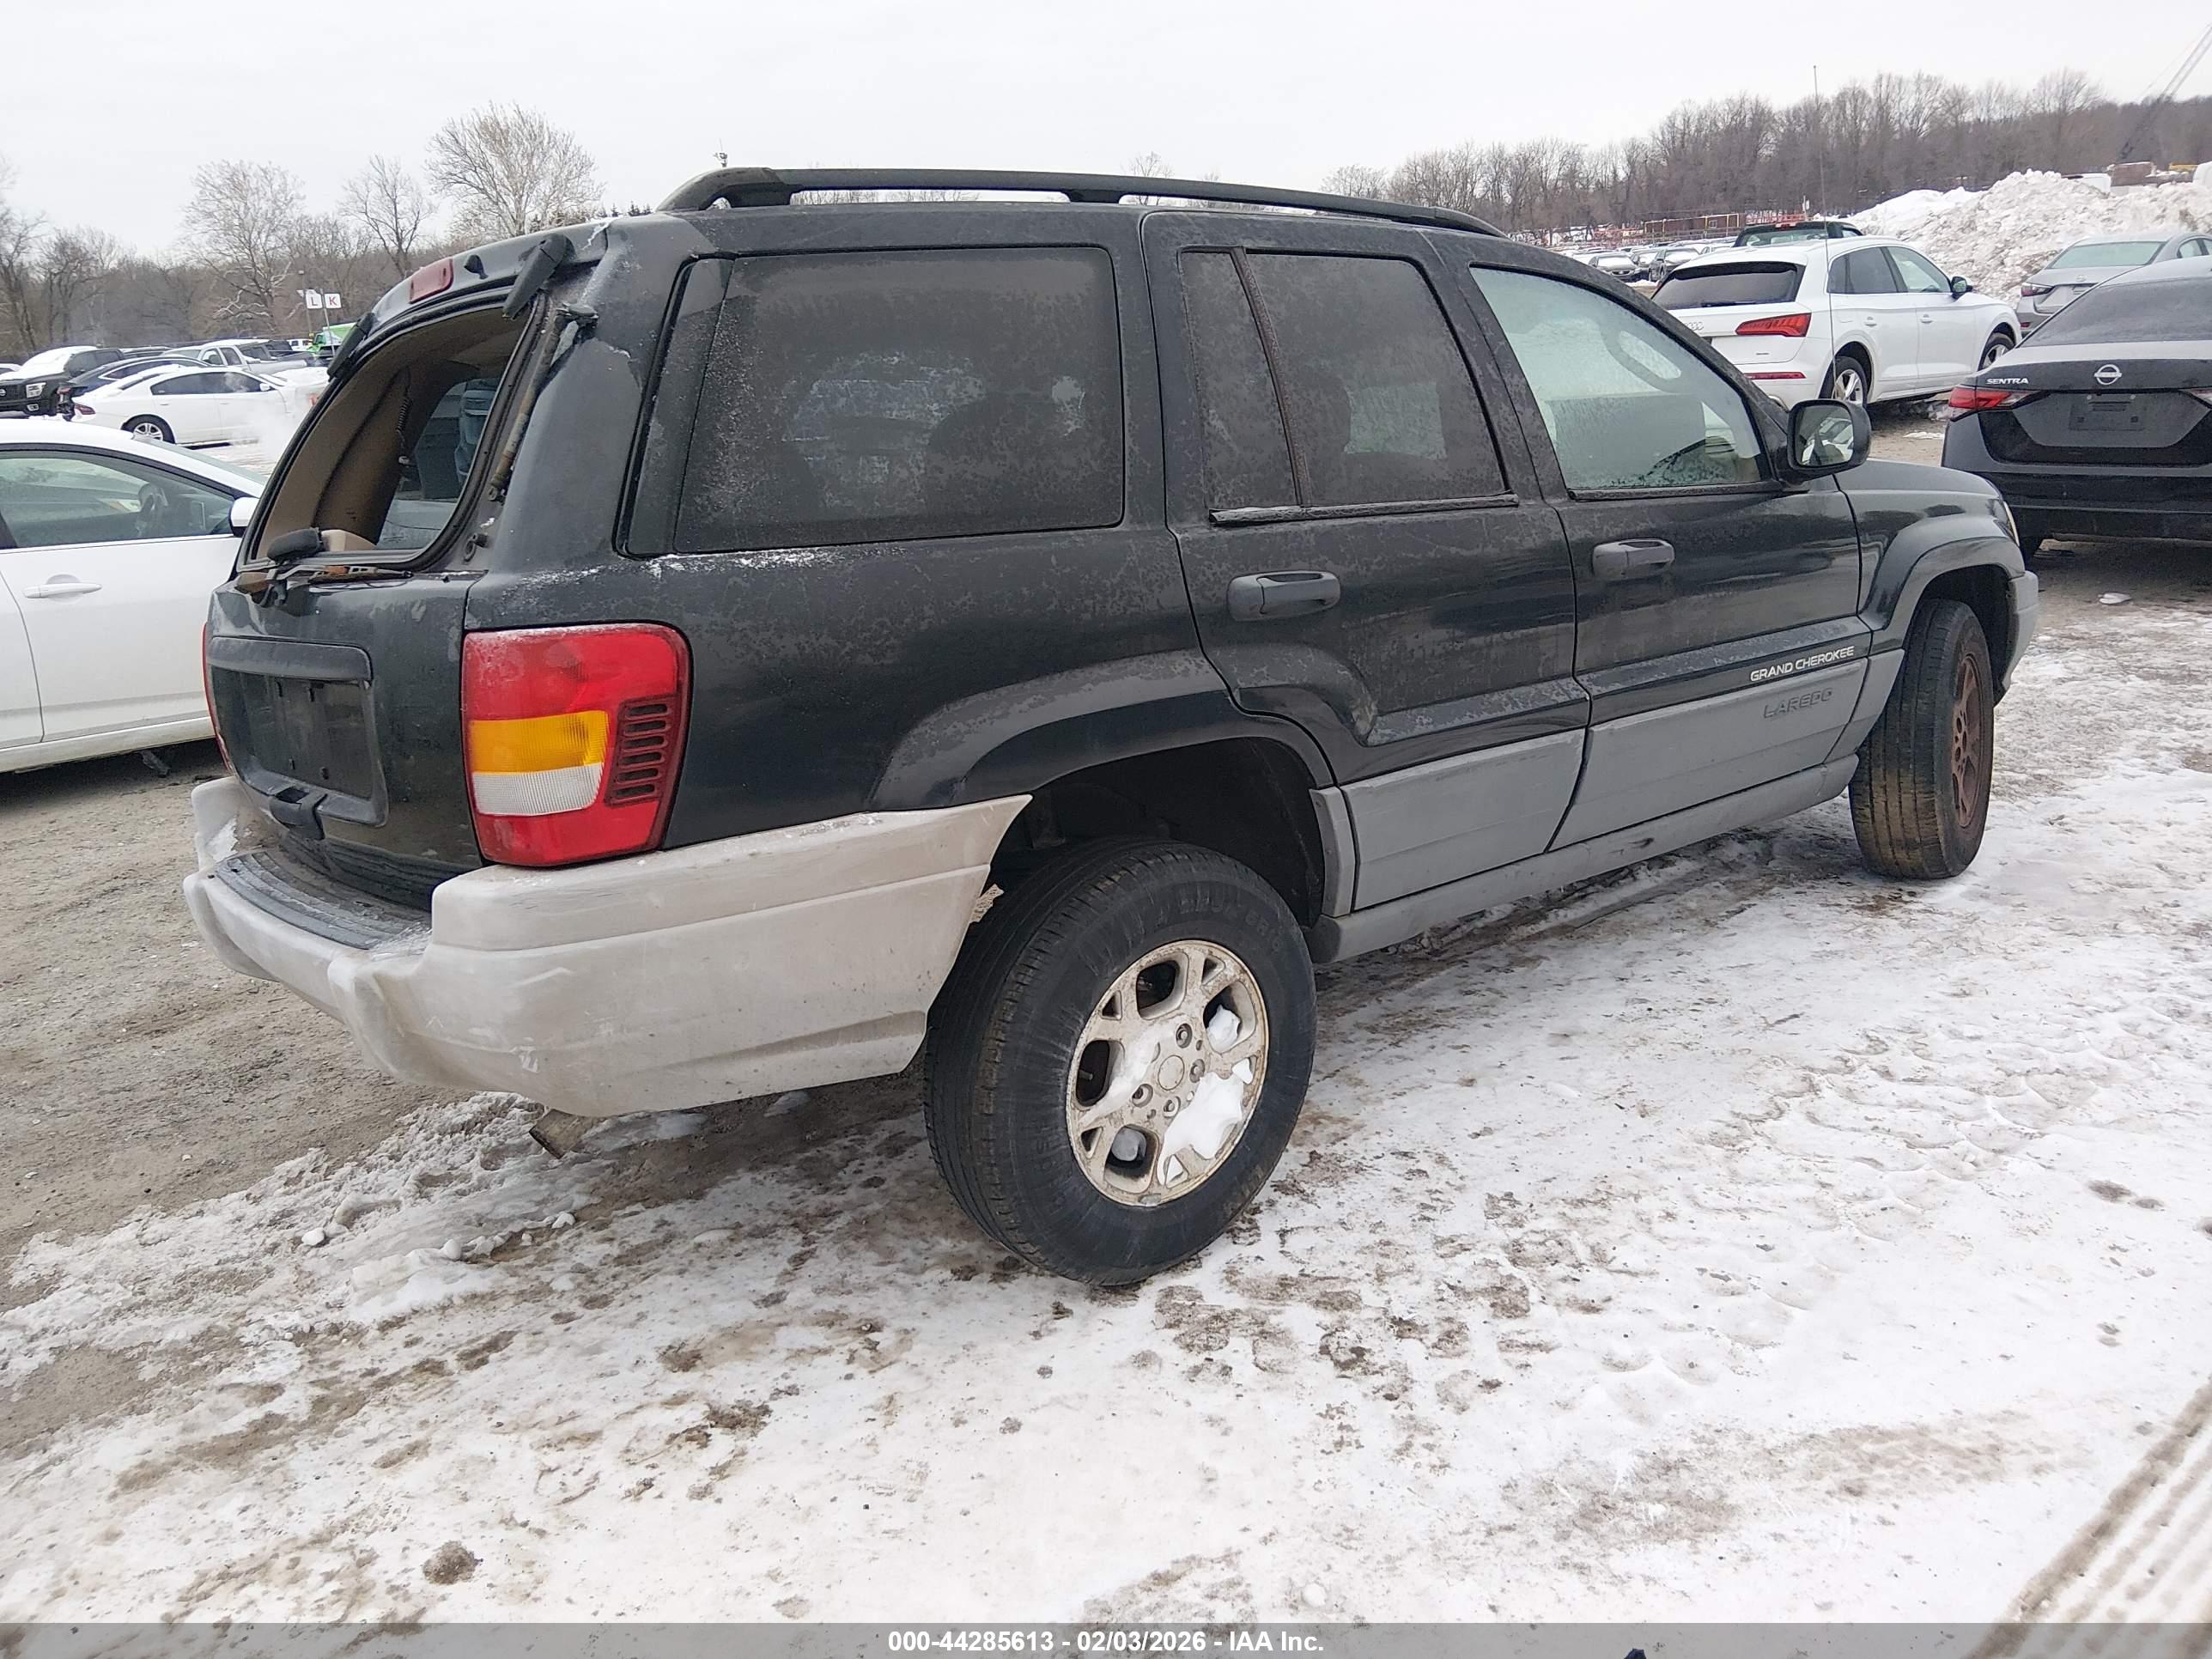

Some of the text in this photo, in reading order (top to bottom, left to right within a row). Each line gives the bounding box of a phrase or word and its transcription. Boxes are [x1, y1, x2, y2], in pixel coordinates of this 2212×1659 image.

[311, 296, 319, 307] L
[329, 296, 337, 306] K
[1750, 646, 1855, 682] GRAND CHEROKEE
[1763, 687, 1833, 719] LAREDO
